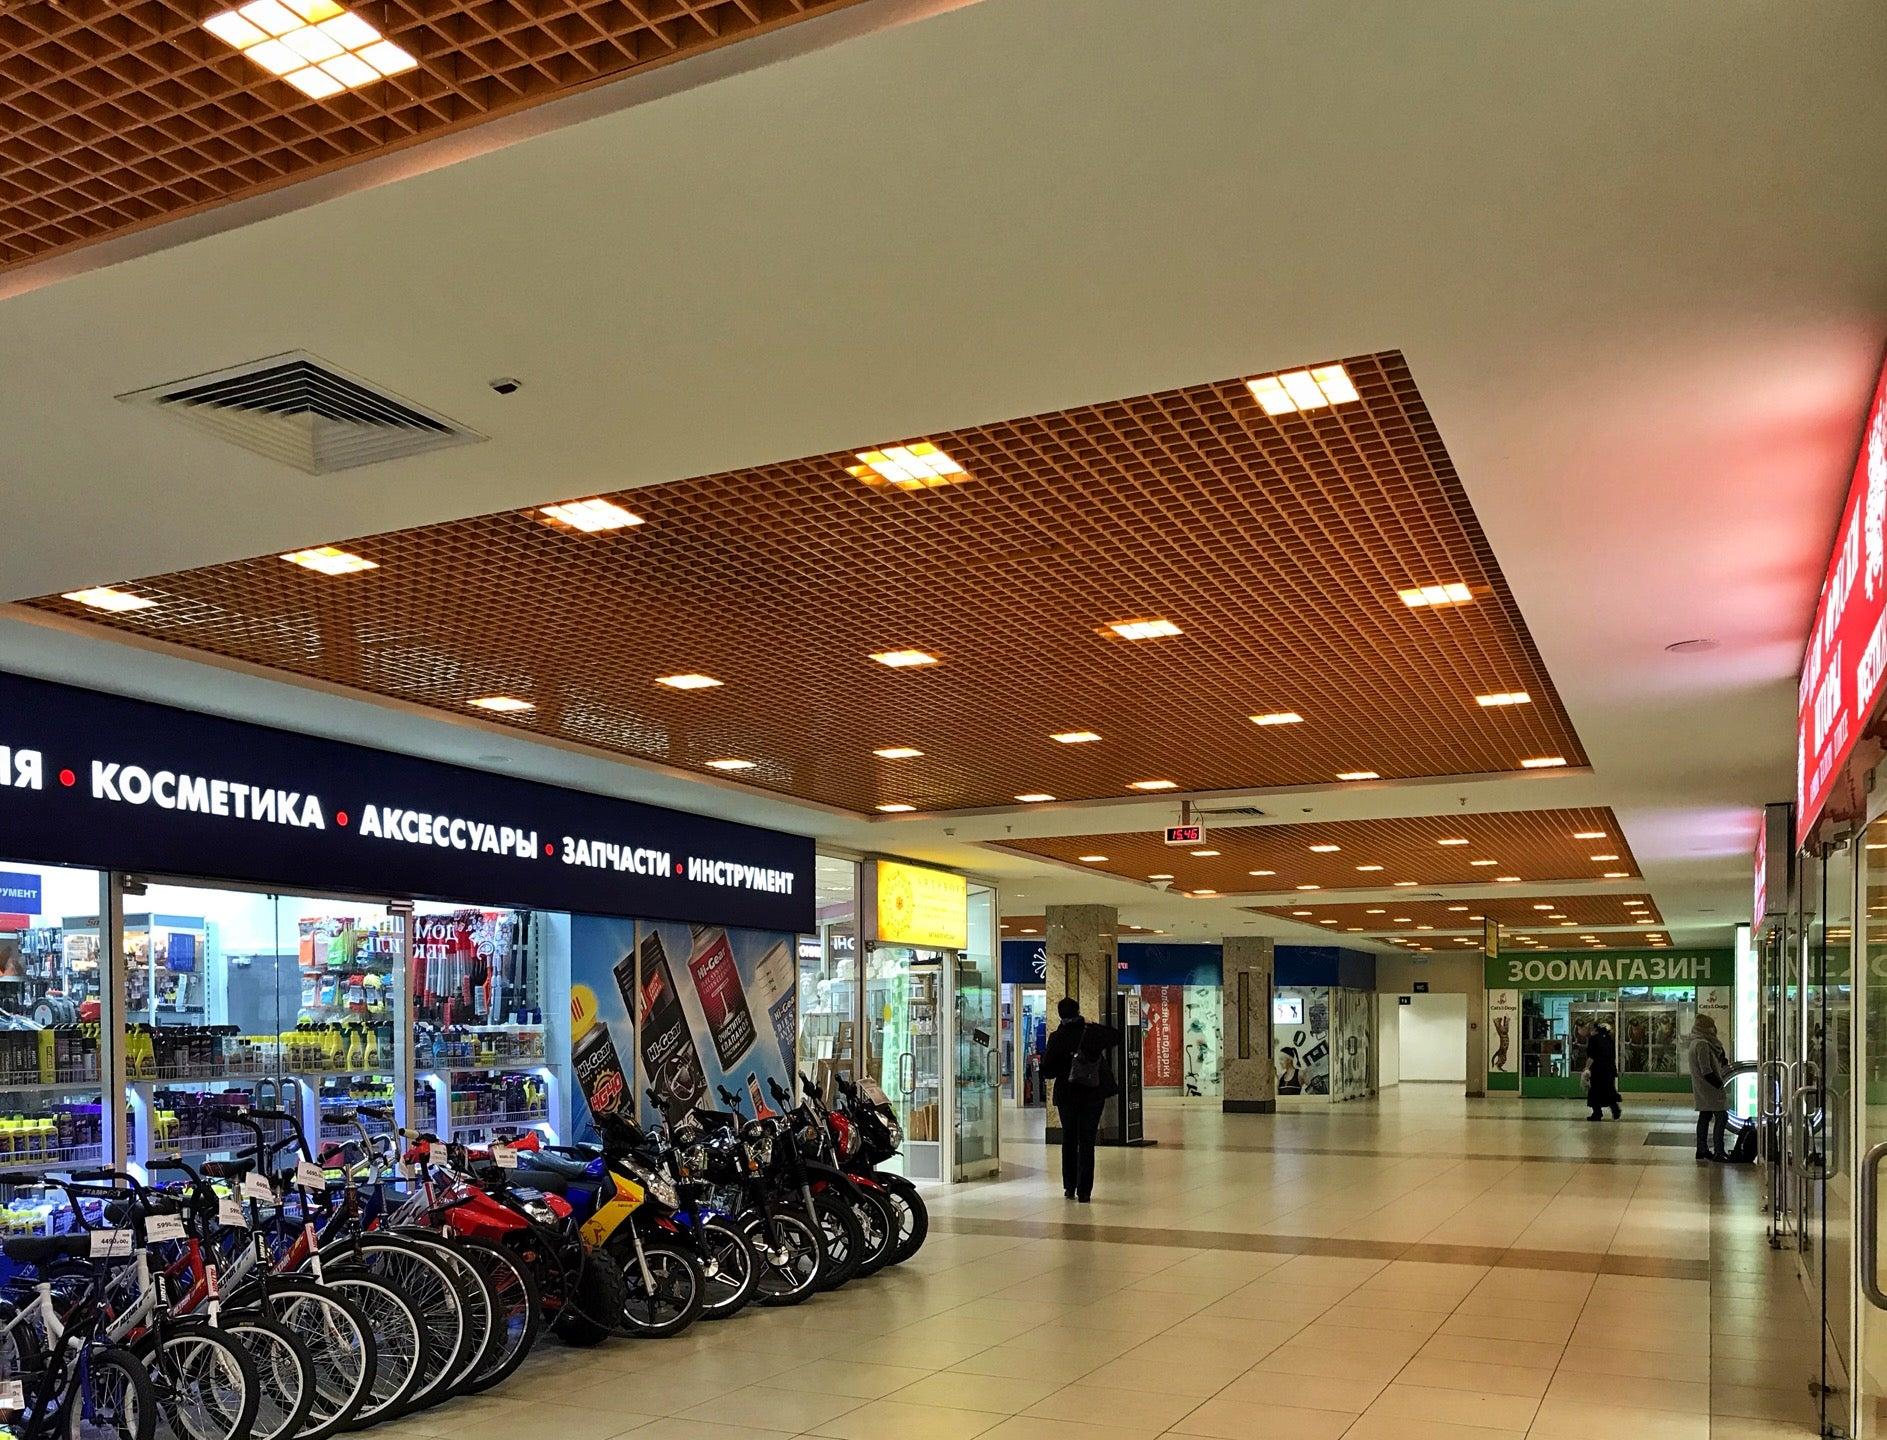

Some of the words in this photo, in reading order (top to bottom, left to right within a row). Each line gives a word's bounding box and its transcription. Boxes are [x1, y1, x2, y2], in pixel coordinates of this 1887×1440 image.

[92, 760, 325, 830] КОСМЕТИКА
[359, 804, 539, 860] АКСЕССУАРЫ
[562, 837, 671, 877] ЗАПЧАСТИ
[687, 857, 794, 896] ИНСТРУМЕНТ
[697, 947, 726, 981] Hi-Gear
[1508, 957, 1711, 982] ЗООМАГАЗИН
[577, 1041, 611, 1078] Hi-Gear
[646, 1021, 682, 1062] Hi-Gear
